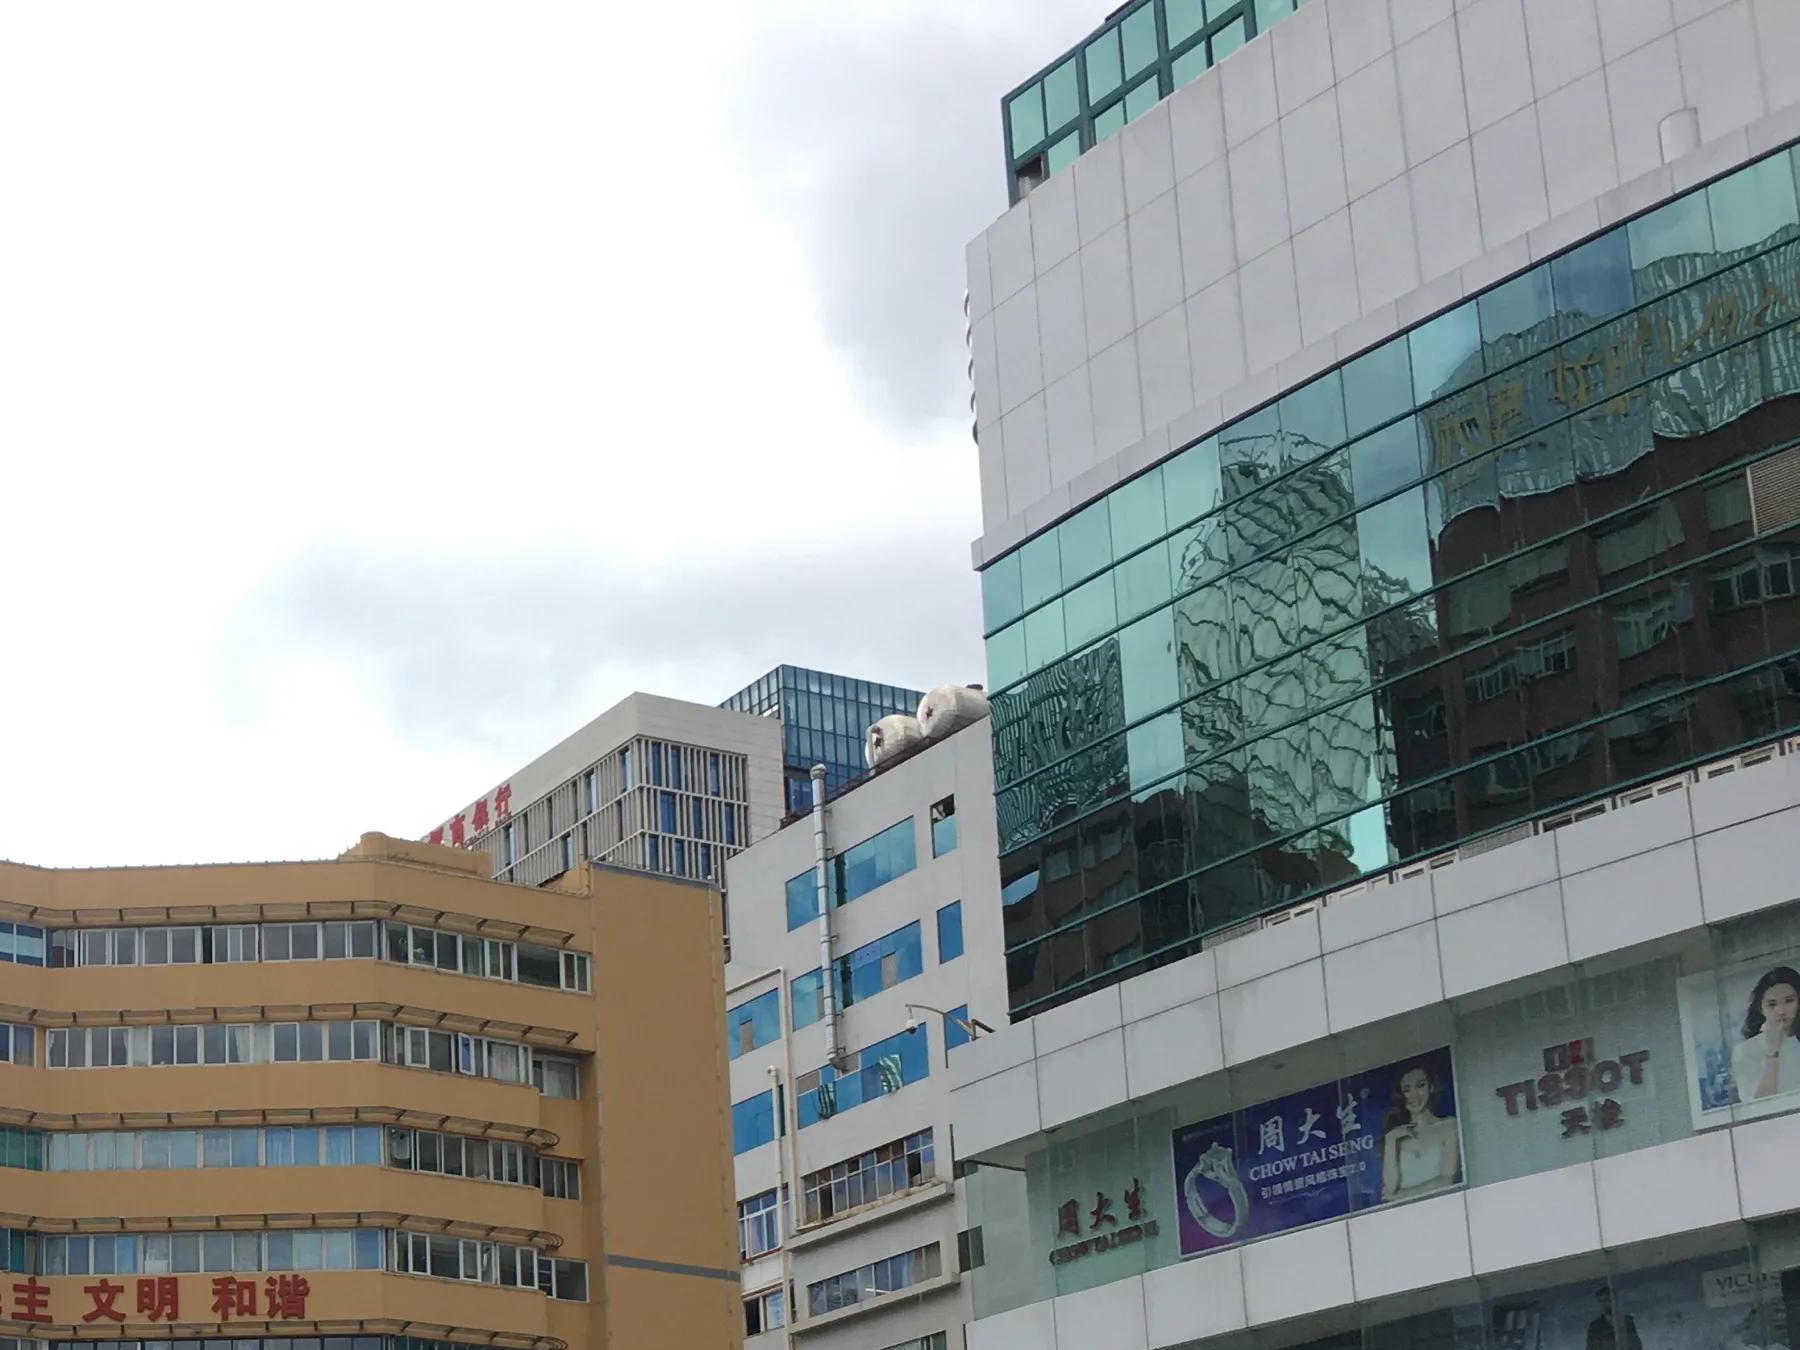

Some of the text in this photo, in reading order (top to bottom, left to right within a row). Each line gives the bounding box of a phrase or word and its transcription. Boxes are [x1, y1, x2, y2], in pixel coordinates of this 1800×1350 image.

[1496, 1050, 1649, 1116] TISSOT
[1258, 1093, 1361, 1155] 周大生
[1250, 1135, 1374, 1181] CHOW TAI SENG
[82, 1277, 180, 1322] 文明
[211, 1275, 311, 1320] 和谐
